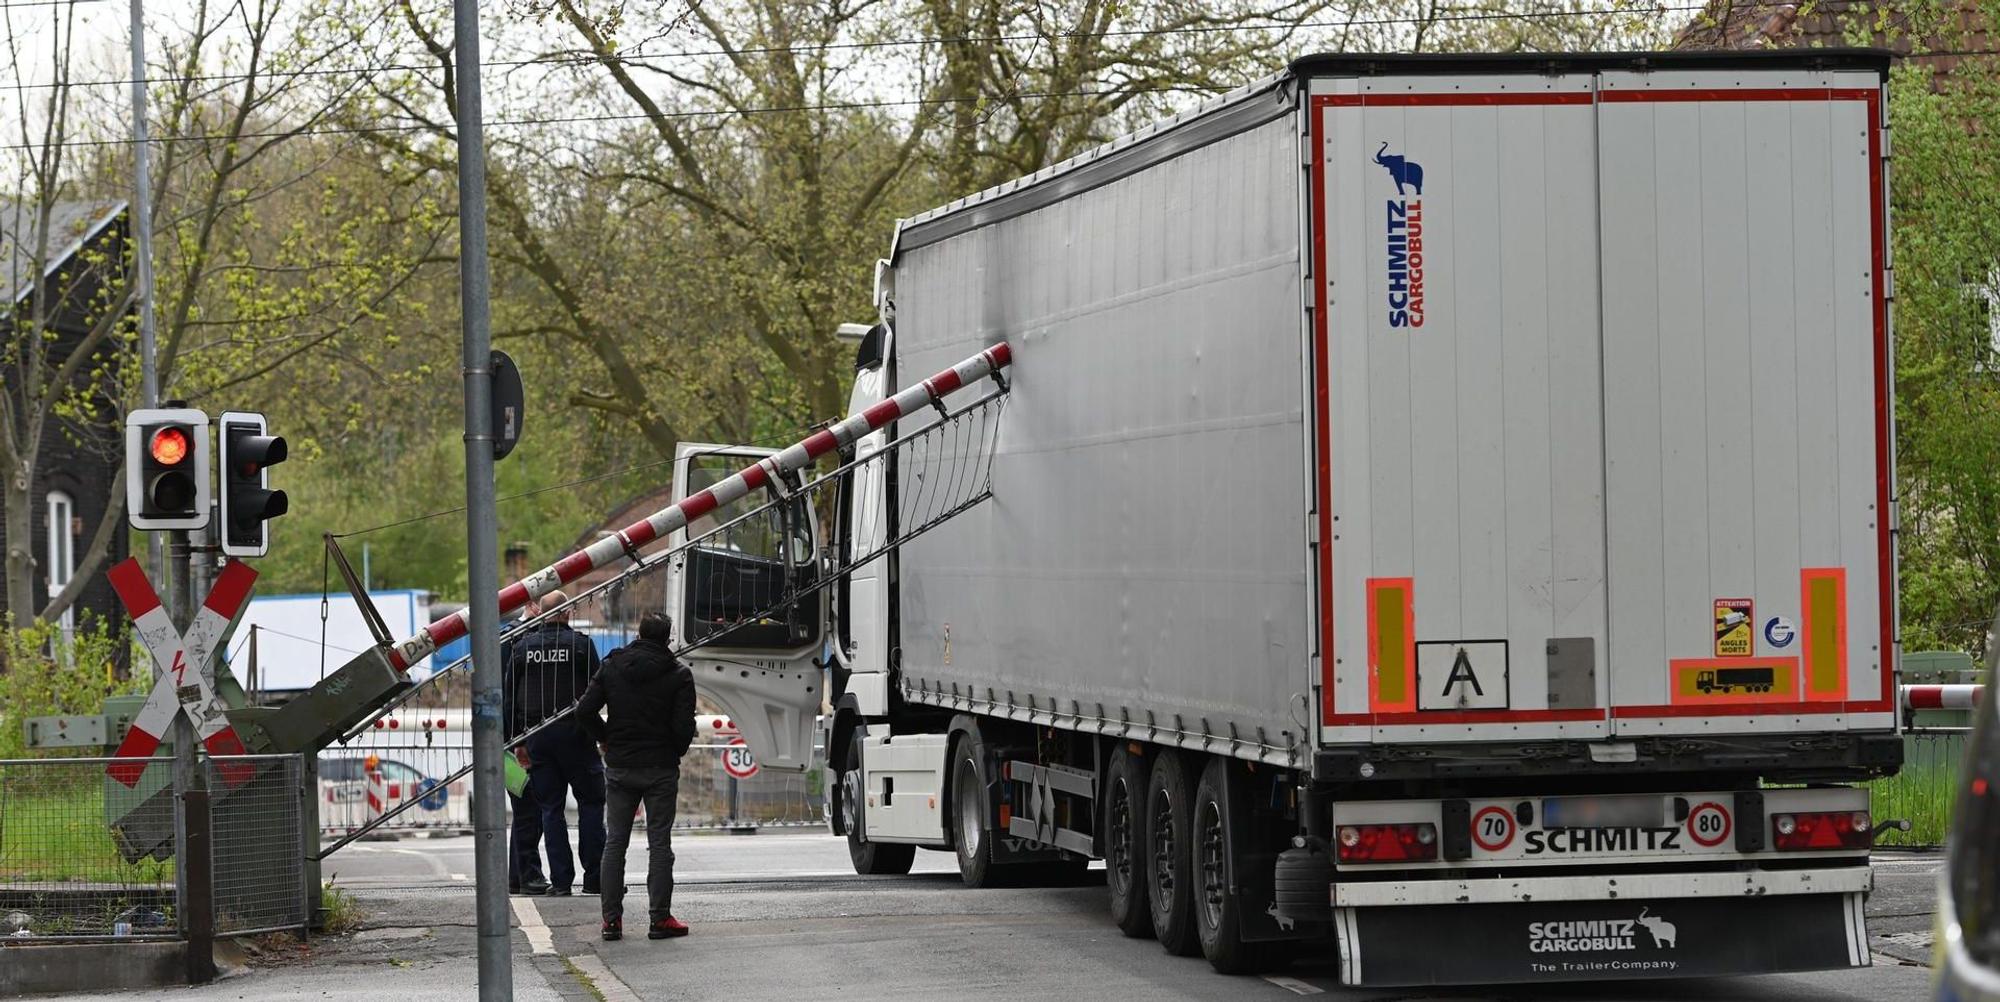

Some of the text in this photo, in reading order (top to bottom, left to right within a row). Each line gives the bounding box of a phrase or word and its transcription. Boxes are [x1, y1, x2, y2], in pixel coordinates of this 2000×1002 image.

[1387, 200, 1409, 328] SCHMITZ
[1407, 200, 1424, 328] CARGOBULL
[526, 649, 569, 664] POLIZEI
[1442, 648, 1484, 696] A
[731, 747, 753, 767] 30
[1484, 818, 1505, 836] 70
[1699, 814, 1721, 832] 80
[1524, 827, 1681, 854] SCHMITZ
[1528, 919, 1635, 939] SCHMITZ
[1529, 937, 1636, 953] CARGOBULL
[1531, 963, 1557, 972] The
